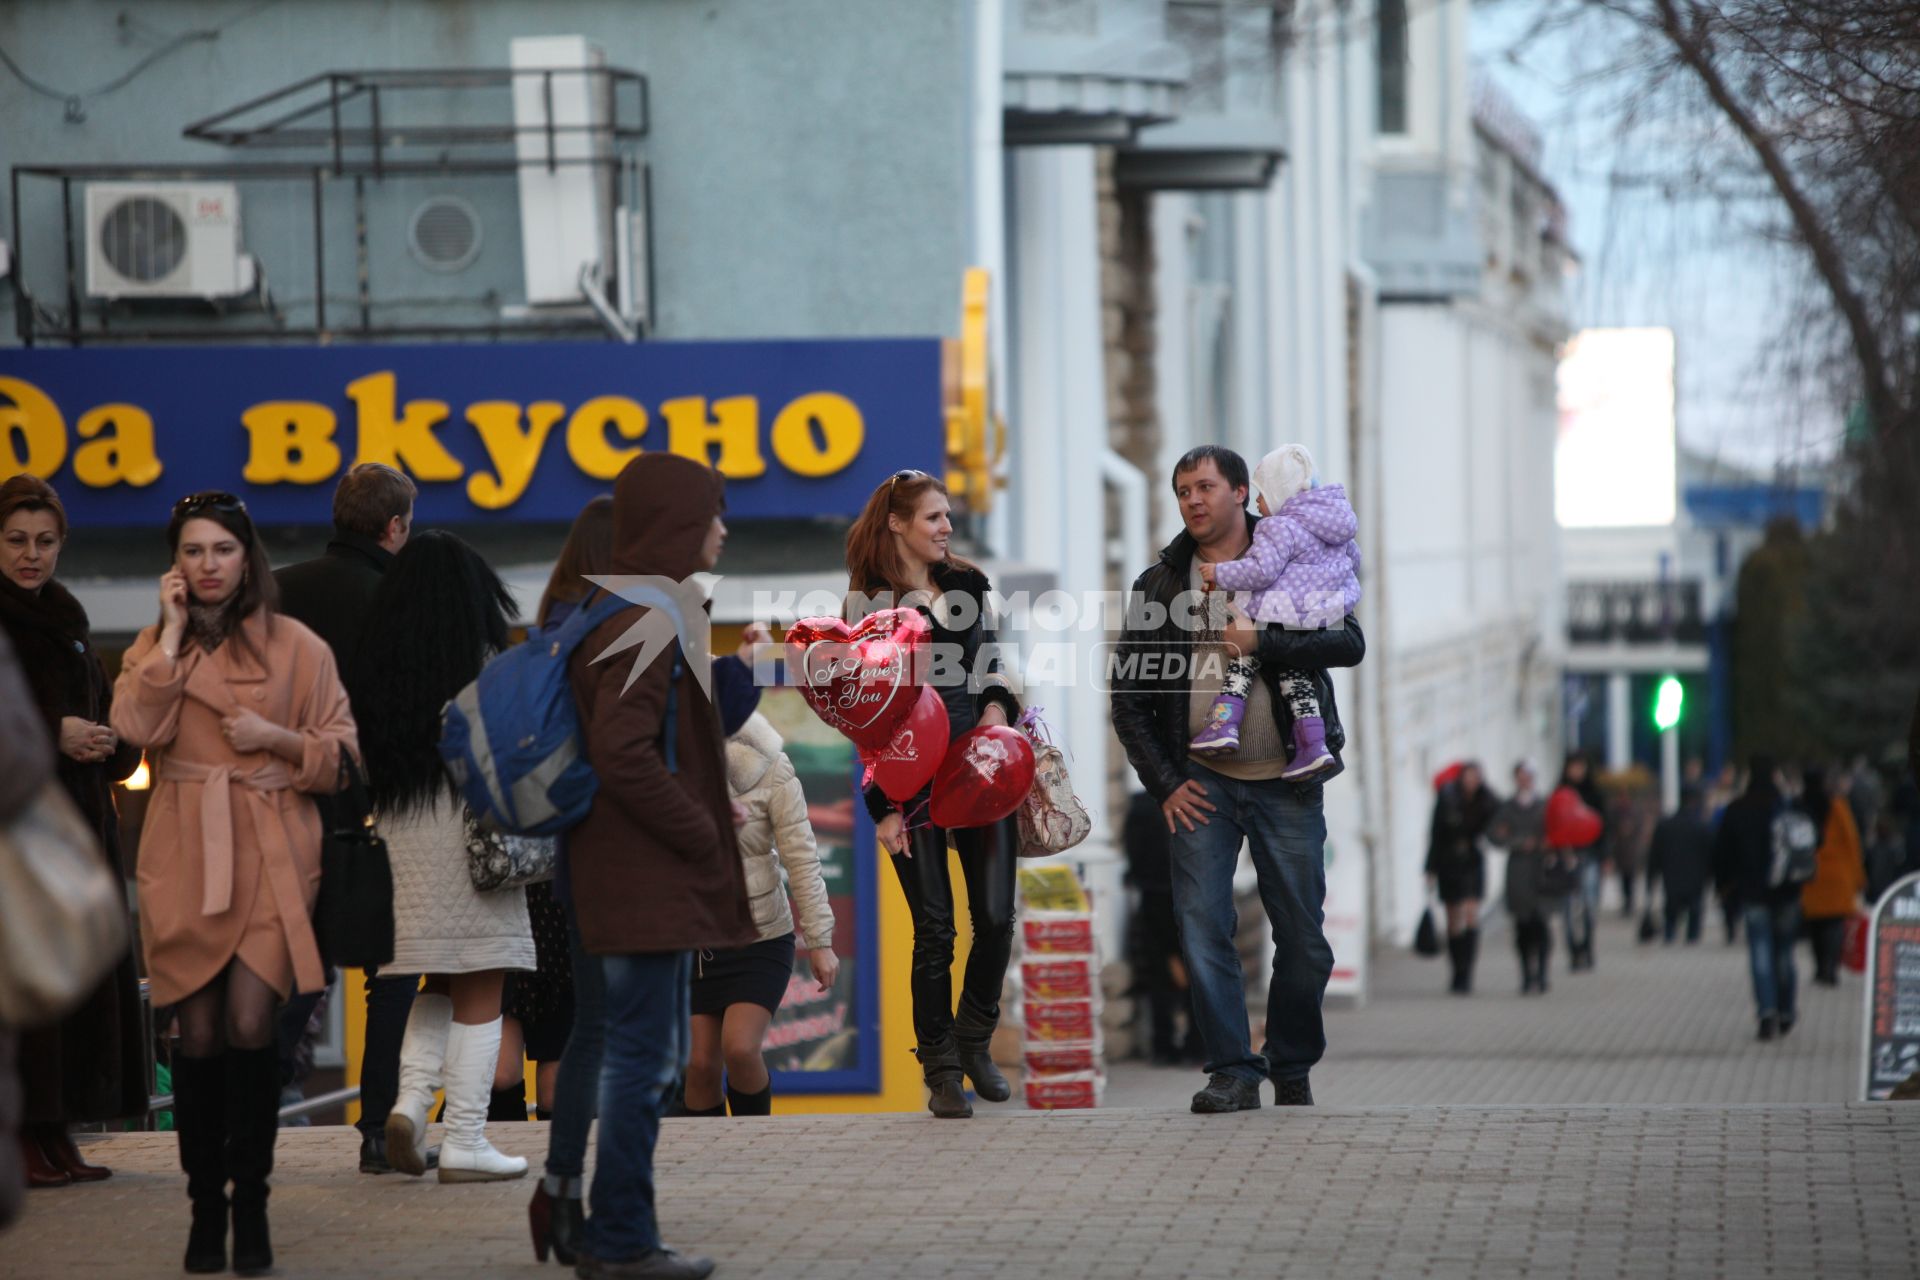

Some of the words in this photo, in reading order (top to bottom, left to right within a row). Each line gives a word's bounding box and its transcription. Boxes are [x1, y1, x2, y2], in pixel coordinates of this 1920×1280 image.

[241, 369, 865, 510] вкусно
[815, 658, 839, 683] I
[841, 658, 891, 681] Love
[838, 681, 883, 709] You
